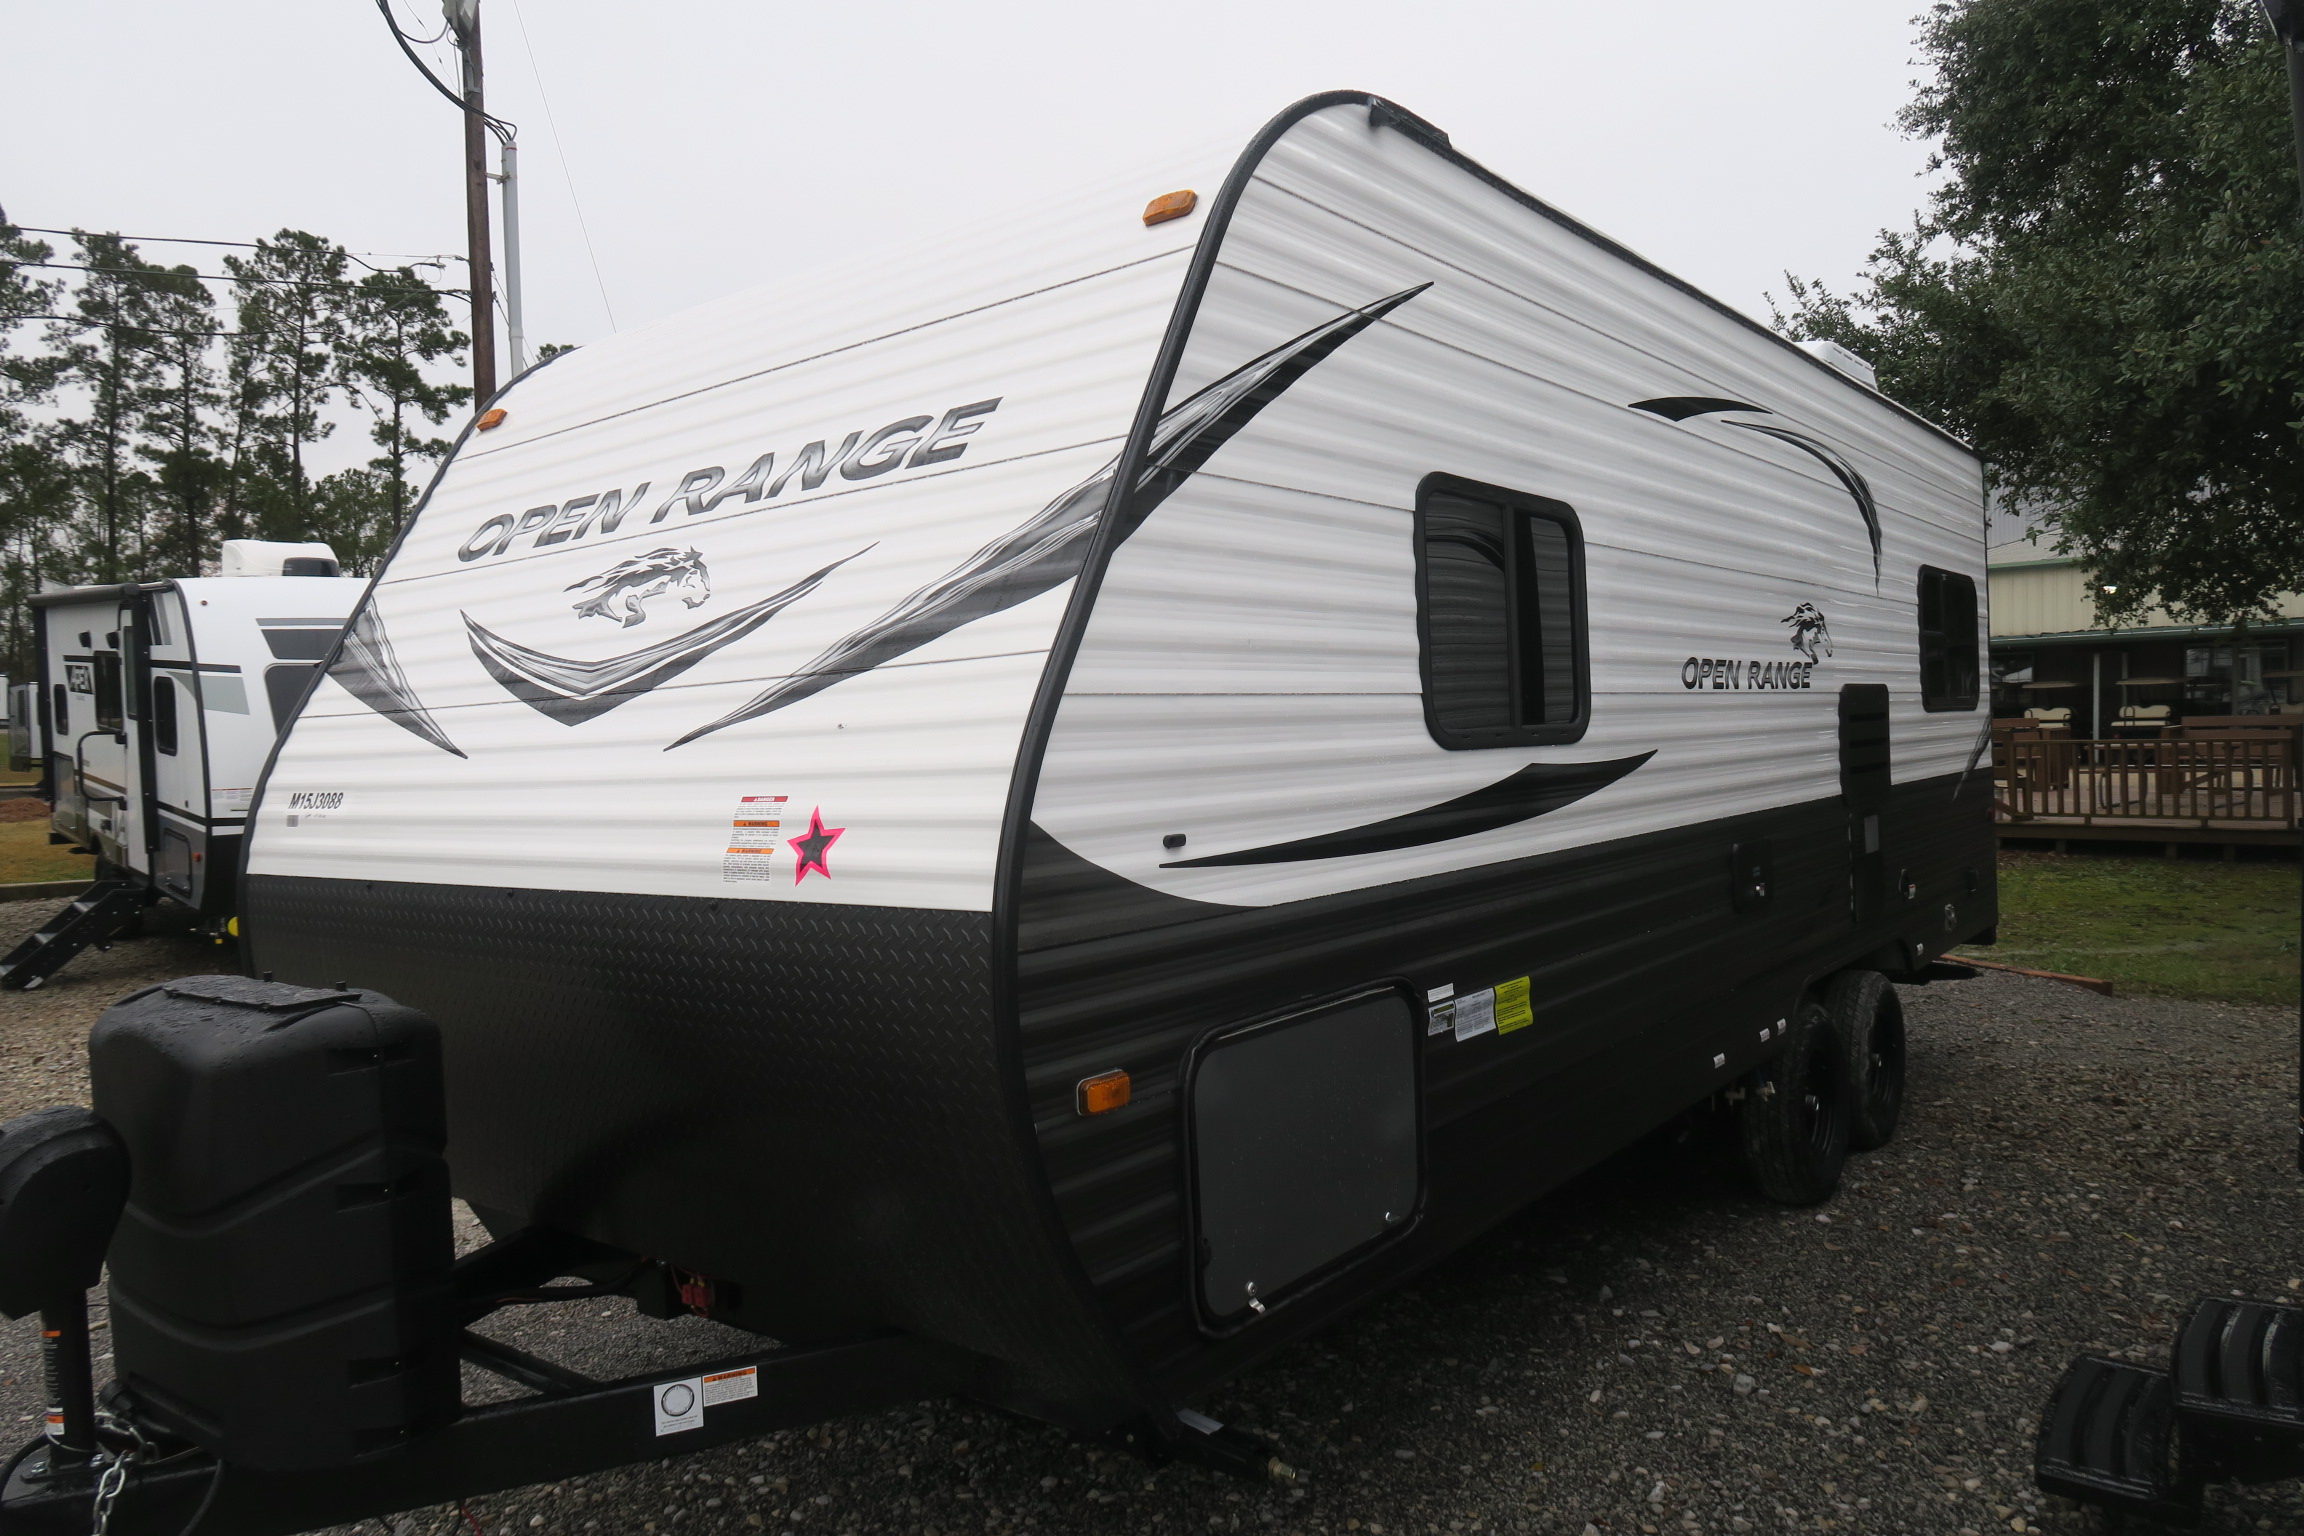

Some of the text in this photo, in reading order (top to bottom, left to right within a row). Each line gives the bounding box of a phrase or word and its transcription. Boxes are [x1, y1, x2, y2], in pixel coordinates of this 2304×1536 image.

[458, 396, 1004, 562] OPEN RANGE
[1681, 656, 1813, 690] OPEN RANGE
[287, 792, 344, 809] M15J3088
[718, 1370, 747, 1380] WARNING
